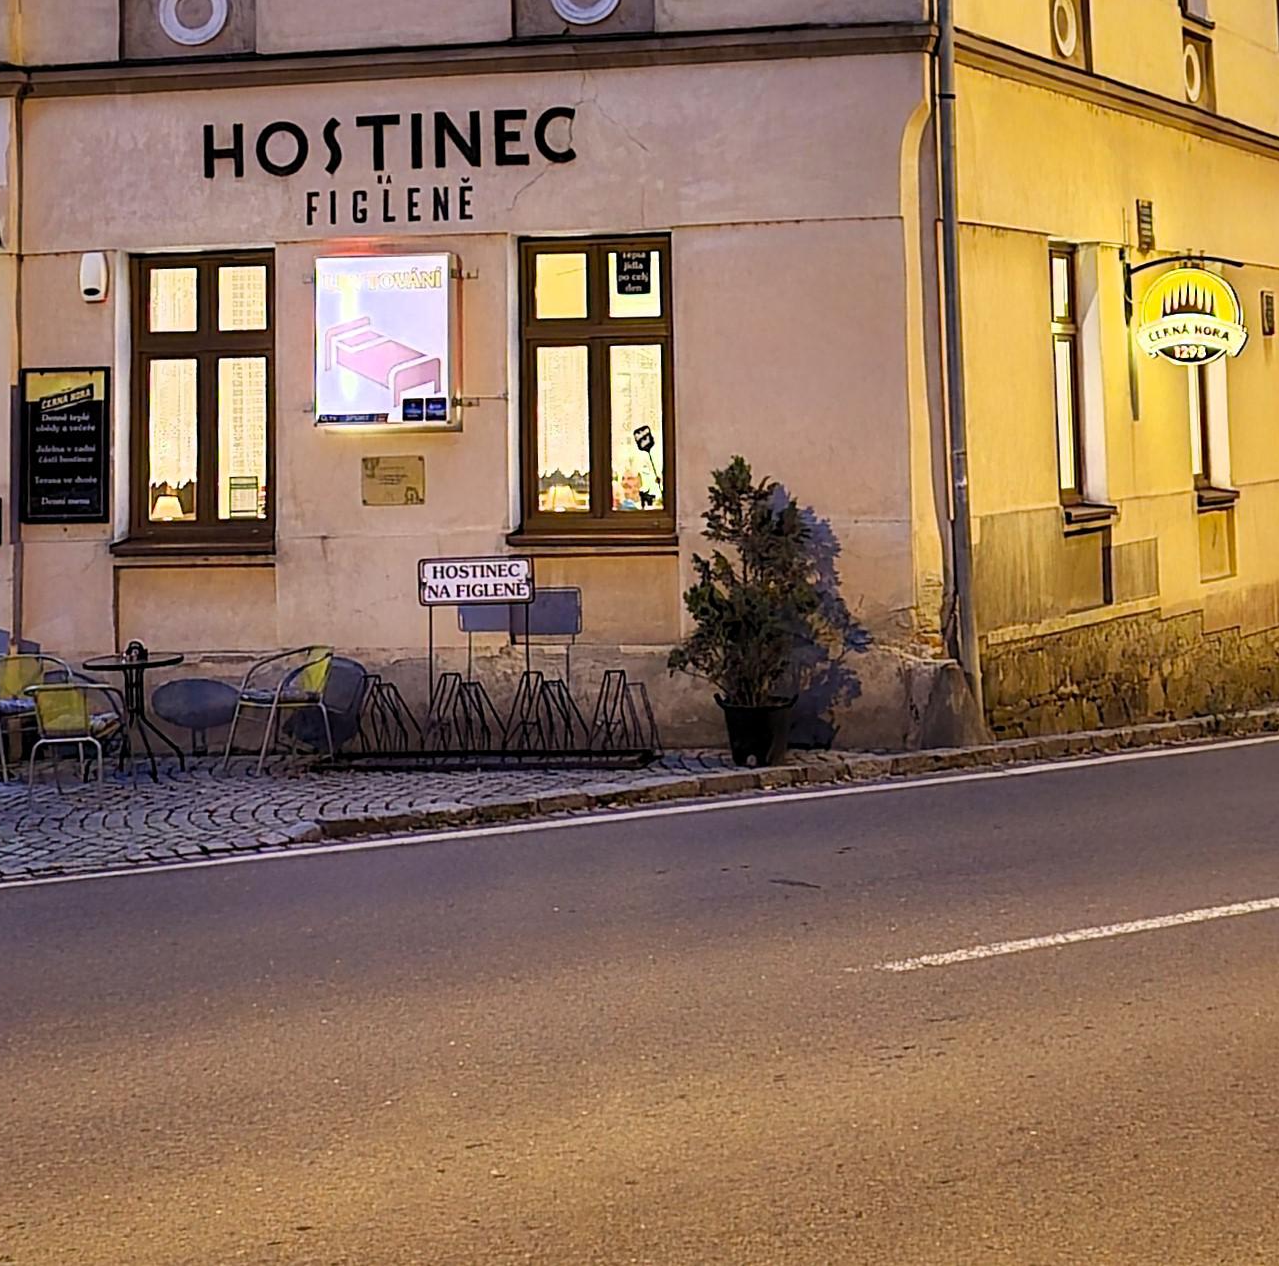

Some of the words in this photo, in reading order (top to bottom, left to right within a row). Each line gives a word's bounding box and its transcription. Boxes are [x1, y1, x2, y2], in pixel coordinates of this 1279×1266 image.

[203, 106, 577, 179] HOSTINEC
[306, 177, 473, 225] FIGLENĚ
[1194, 325, 1230, 342] HORA
[432, 563, 521, 580] HOSTINEC
[427, 584, 451, 599] NA
[456, 579, 527, 598] FIGLENĚ
